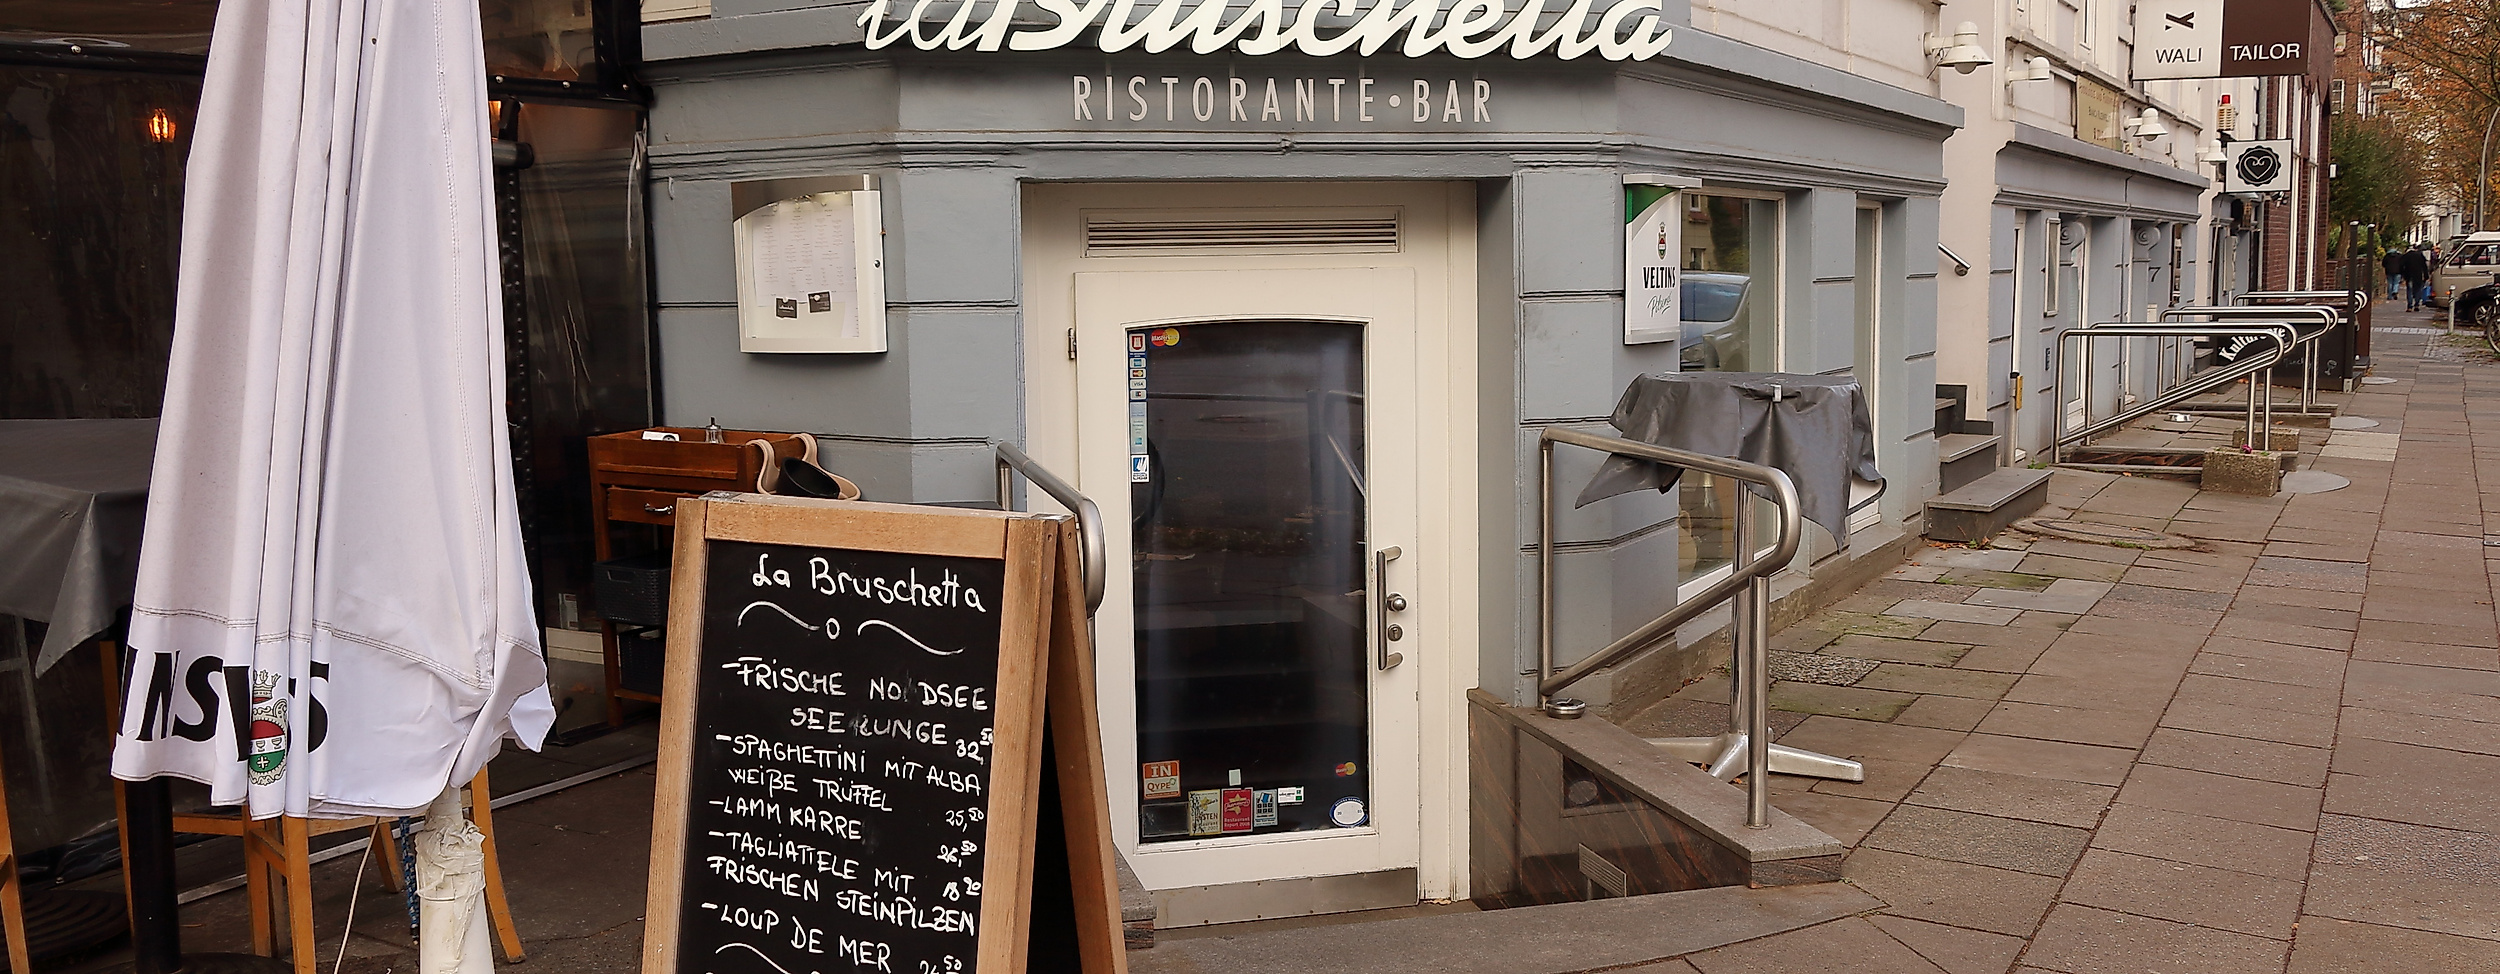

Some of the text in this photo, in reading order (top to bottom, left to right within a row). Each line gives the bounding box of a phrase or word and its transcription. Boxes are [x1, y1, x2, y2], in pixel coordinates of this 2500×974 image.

[2156, 43, 2300, 64] WALI TAILOR
[1072, 75, 1493, 123] RISTORANTE BAR
[1643, 266, 1676, 289] VELTINS
[2148, 266, 2161, 282] 7
[752, 553, 986, 612] La Bruschetta
[885, 755, 923, 779] MIT
[926, 766, 982, 796] ALBA
[1150, 764, 1172, 778] IN
[790, 806, 862, 840] KARRE
[706, 856, 819, 902] FRISCHEN
[836, 890, 975, 936] STEINPILZEN
[874, 866, 915, 895] MIT
[790, 916, 825, 954] DE
[838, 935, 892, 974] MER
